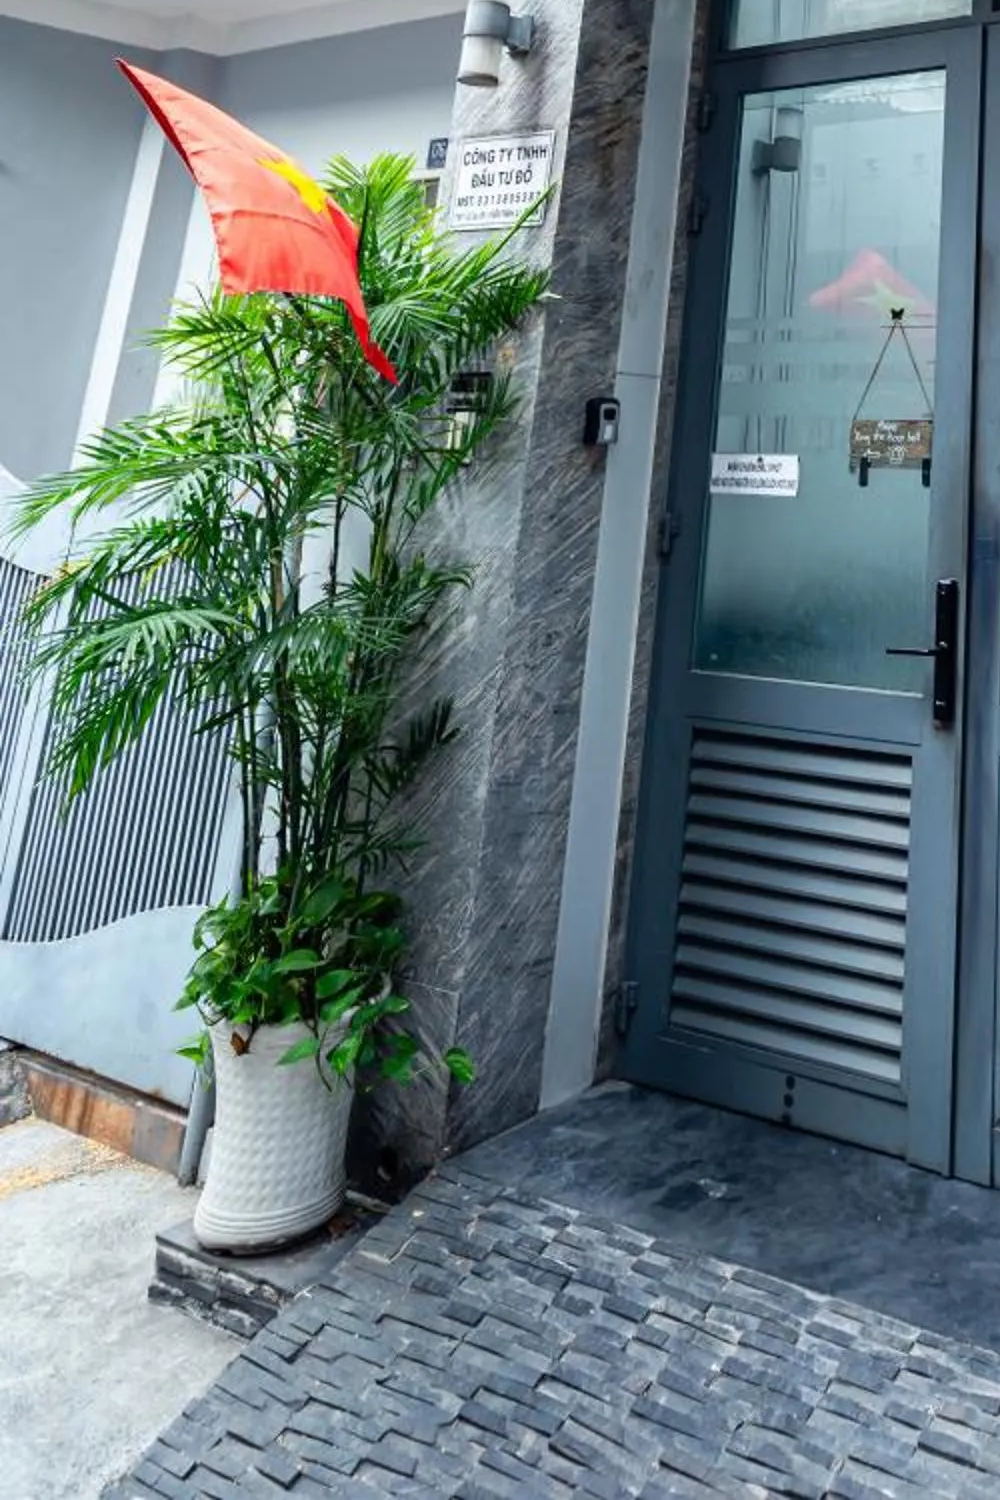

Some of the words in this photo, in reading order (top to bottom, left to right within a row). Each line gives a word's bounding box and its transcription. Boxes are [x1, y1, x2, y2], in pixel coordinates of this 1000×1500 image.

[463, 147, 495, 167] CÔNG
[499, 147, 513, 163] TY
[517, 145, 548, 161] TNHH
